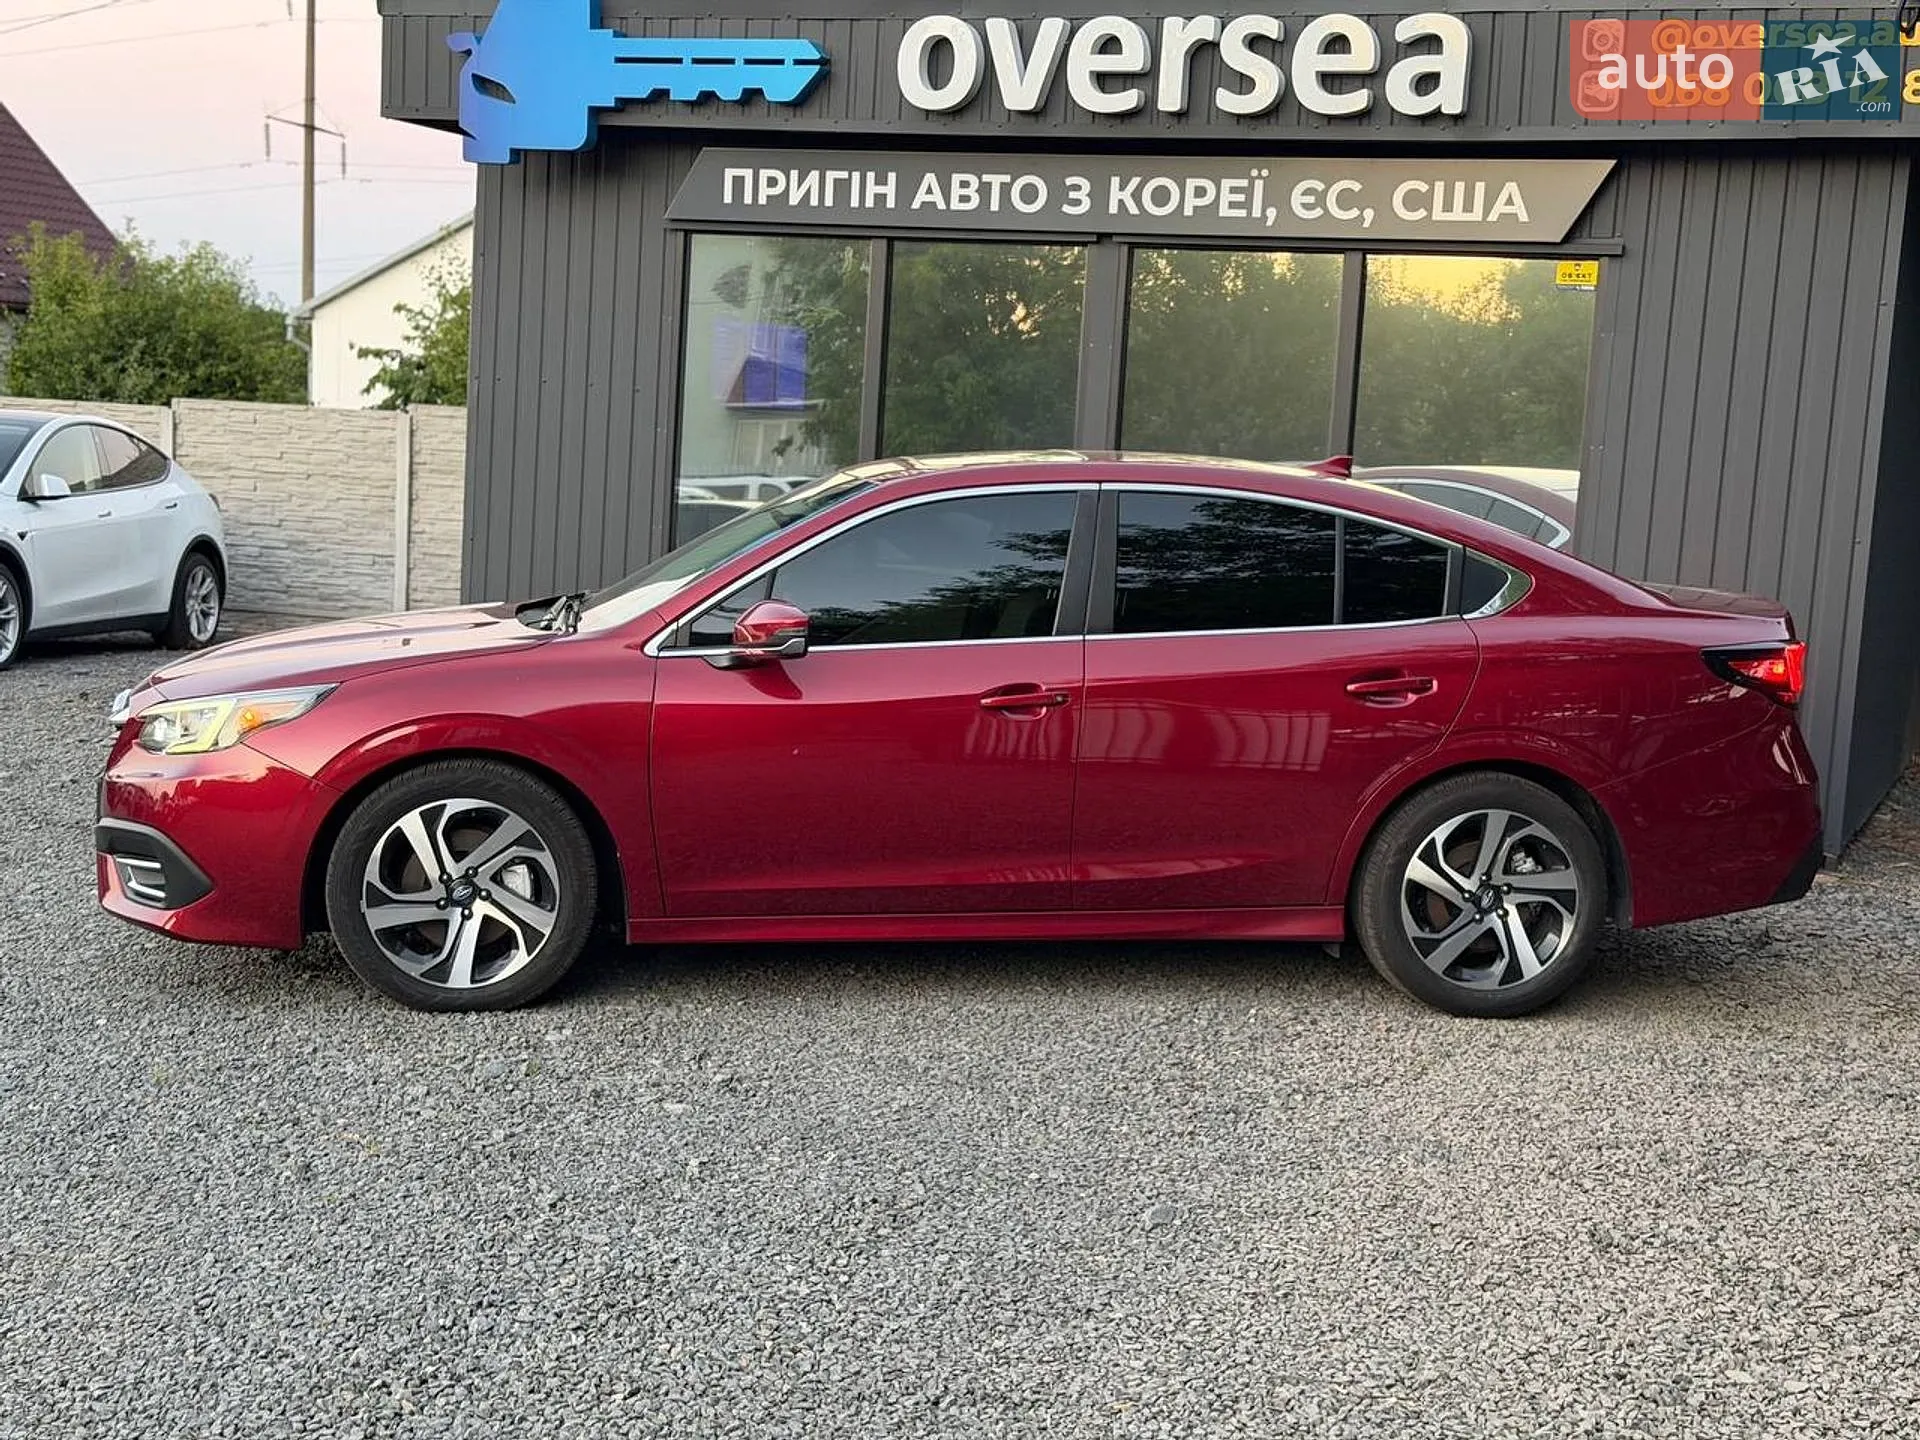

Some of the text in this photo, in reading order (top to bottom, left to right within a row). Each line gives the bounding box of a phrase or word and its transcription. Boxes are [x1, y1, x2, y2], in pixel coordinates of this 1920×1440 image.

[897, 13, 1471, 117] oversea
[723, 167, 1529, 228] ПРИГІН АВТО З КОРЕЇ, ЄС, США
